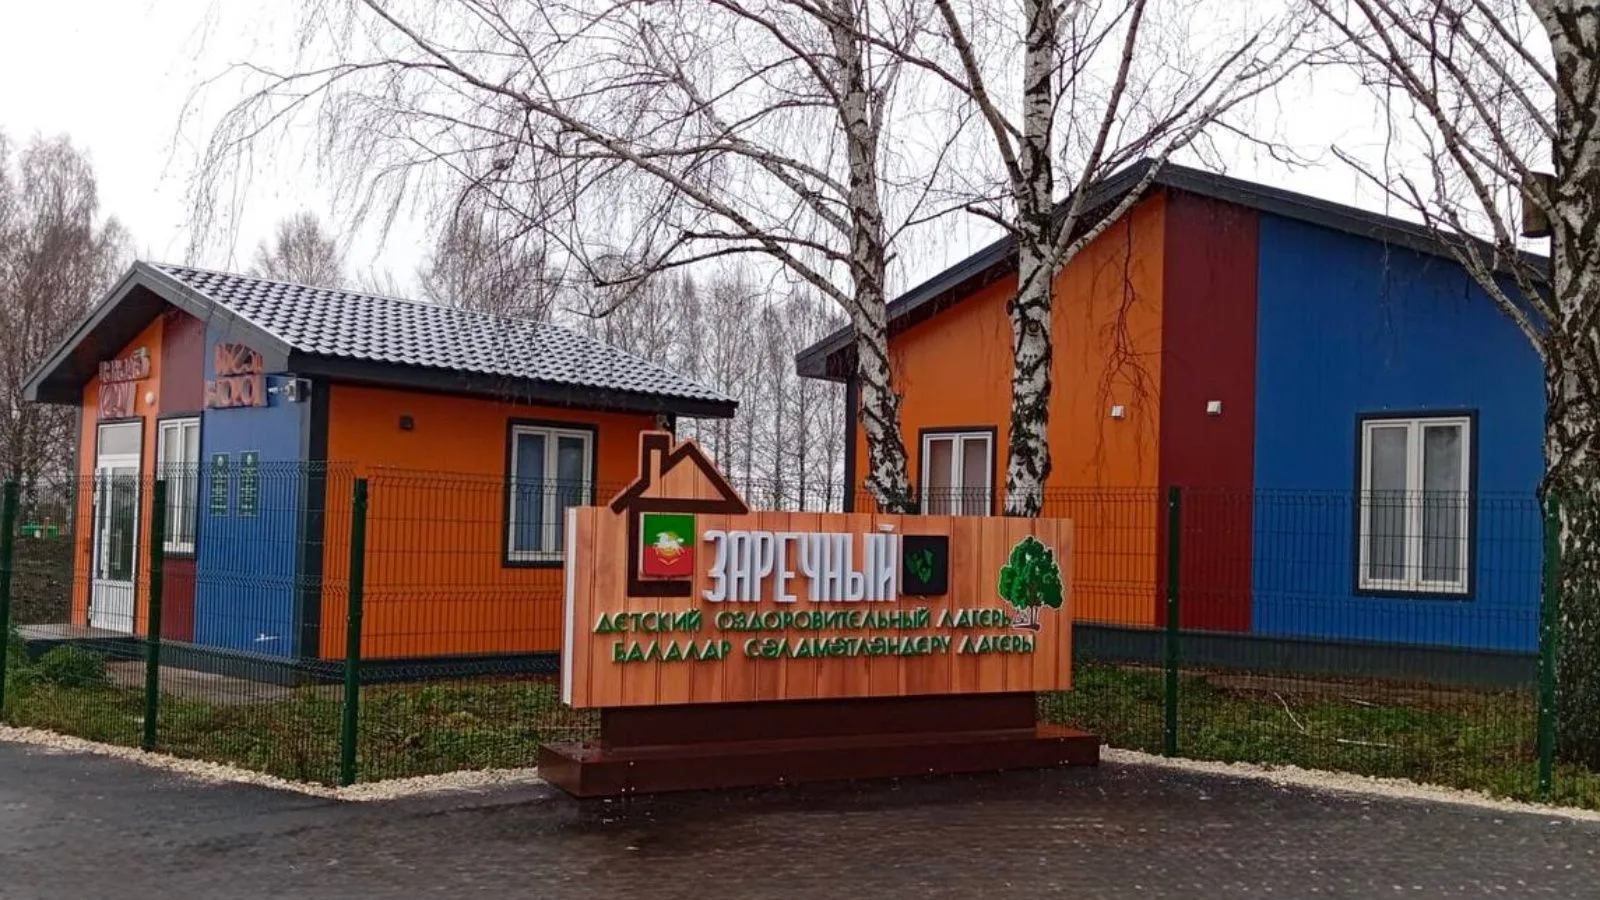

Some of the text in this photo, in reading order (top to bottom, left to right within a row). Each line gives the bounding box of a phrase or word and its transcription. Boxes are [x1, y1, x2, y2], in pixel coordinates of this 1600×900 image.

[702, 523, 898, 603] ЗАРЕЧНЫЙ
[592, 607, 1012, 634] ДЕТСКИЙ ОЗДОРОВИТЕЛЬНЫЙ ЛАГЕРЬ
[611, 639, 731, 663] БАЛАЛАР
[957, 632, 1037, 655] ЛАГЕРЫ
